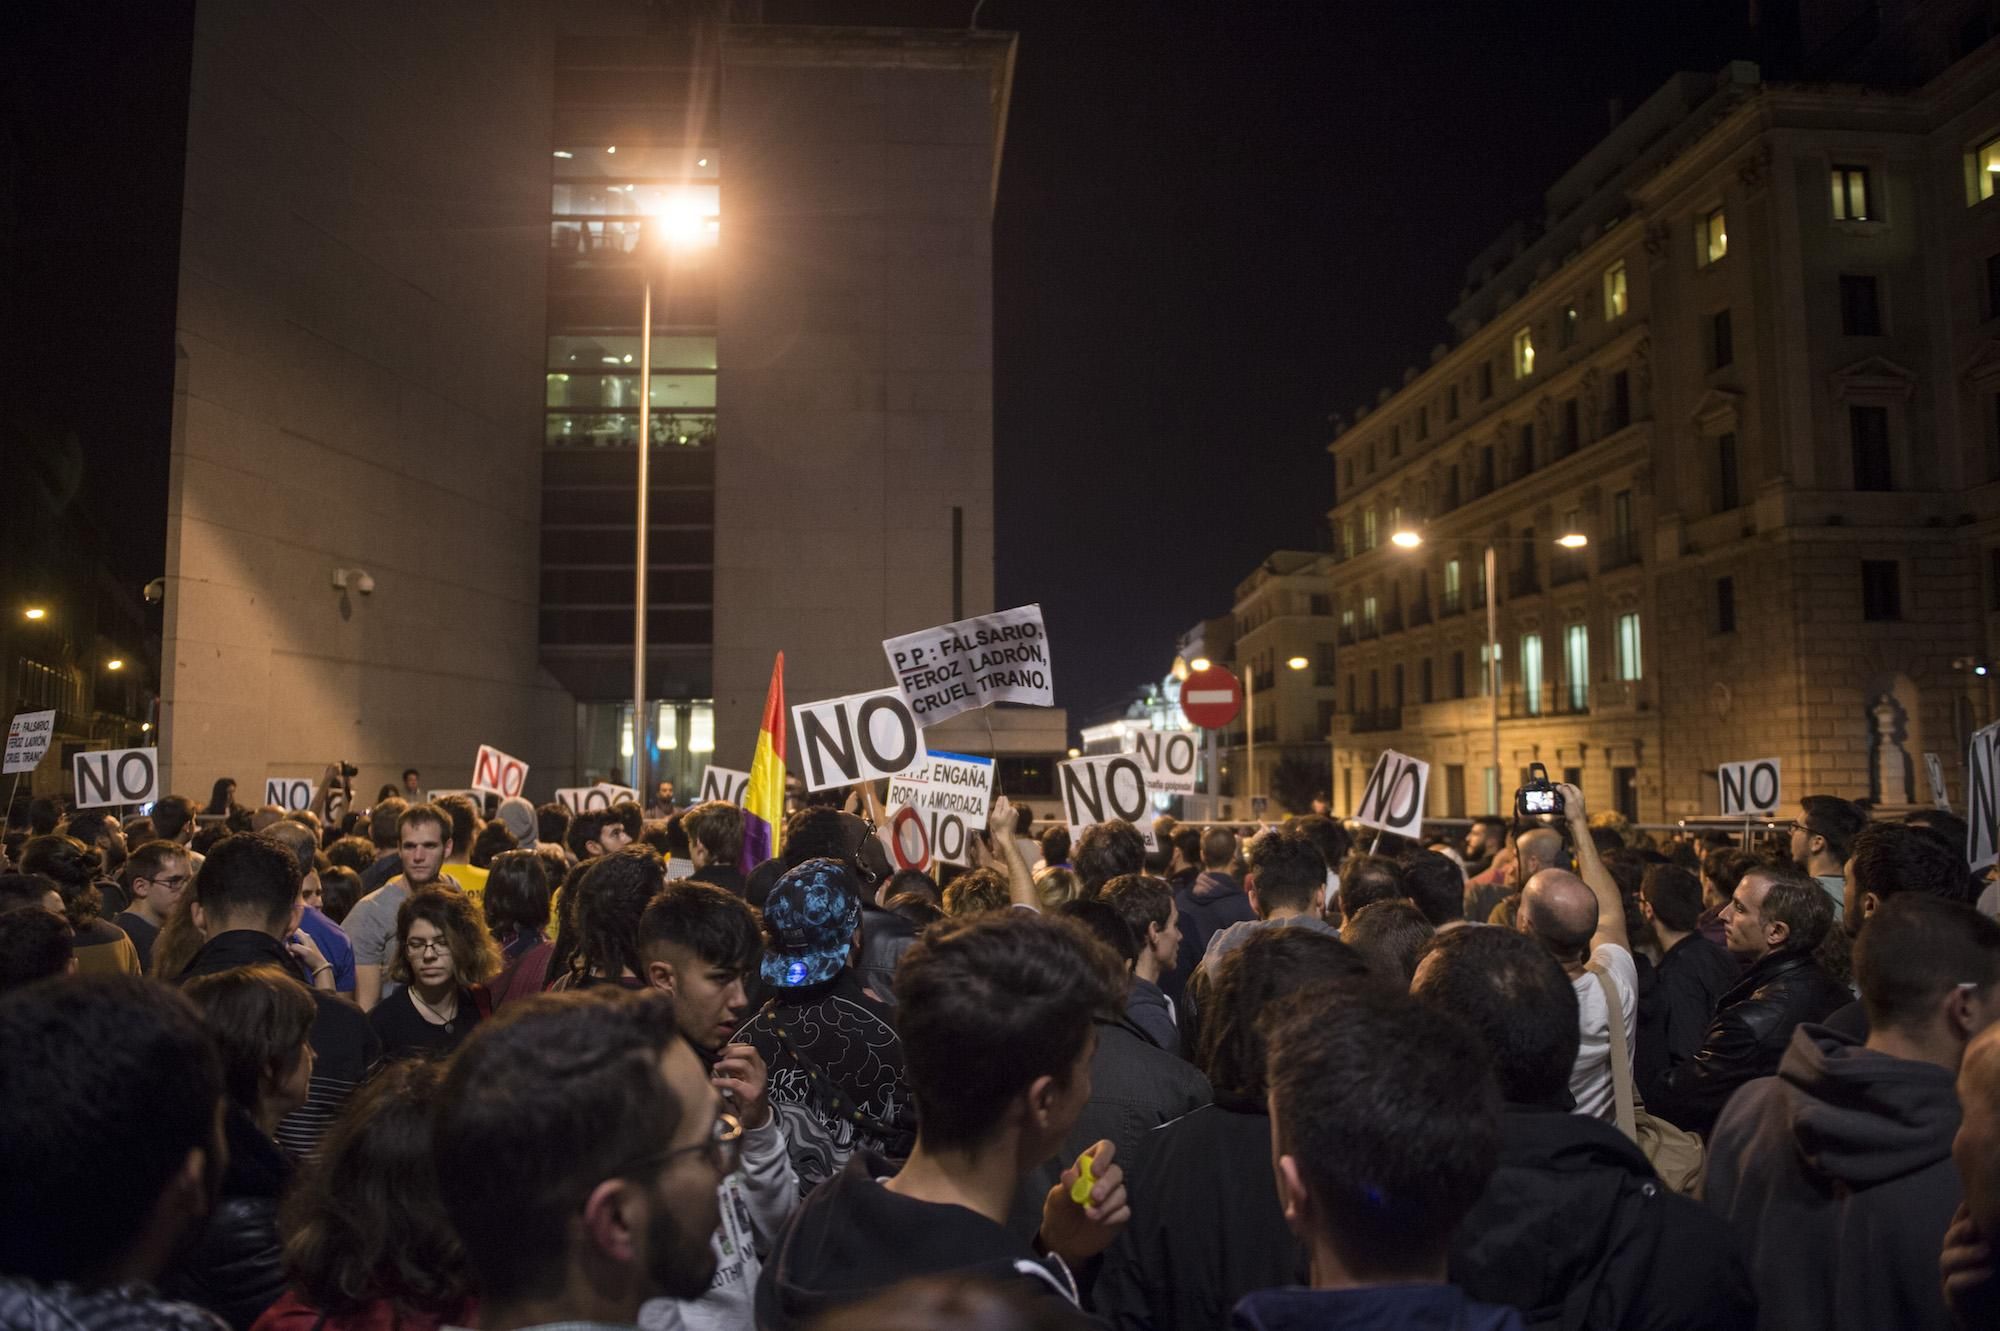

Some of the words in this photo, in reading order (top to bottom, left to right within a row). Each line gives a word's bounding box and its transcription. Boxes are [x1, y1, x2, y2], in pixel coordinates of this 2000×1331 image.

[940, 622, 1043, 657] FALSARIO,
[903, 660, 962, 693] FEROZ
[968, 643, 1047, 673] LADRÓN,
[912, 681, 976, 714] CRUEL
[977, 671, 1048, 692] TIRANO.
[800, 694, 918, 787] NO
[1136, 732, 1194, 775] NO
[76, 751, 154, 804] NO
[267, 781, 310, 810] NO
[476, 749, 524, 799] NO
[932, 764, 989, 792] ENGAÑA,
[1063, 758, 1147, 826] NO
[1356, 752, 1420, 828] NO
[1721, 762, 1779, 813] NO
[1970, 728, 2000, 863] N
[928, 790, 985, 816] AMORDAZA.
